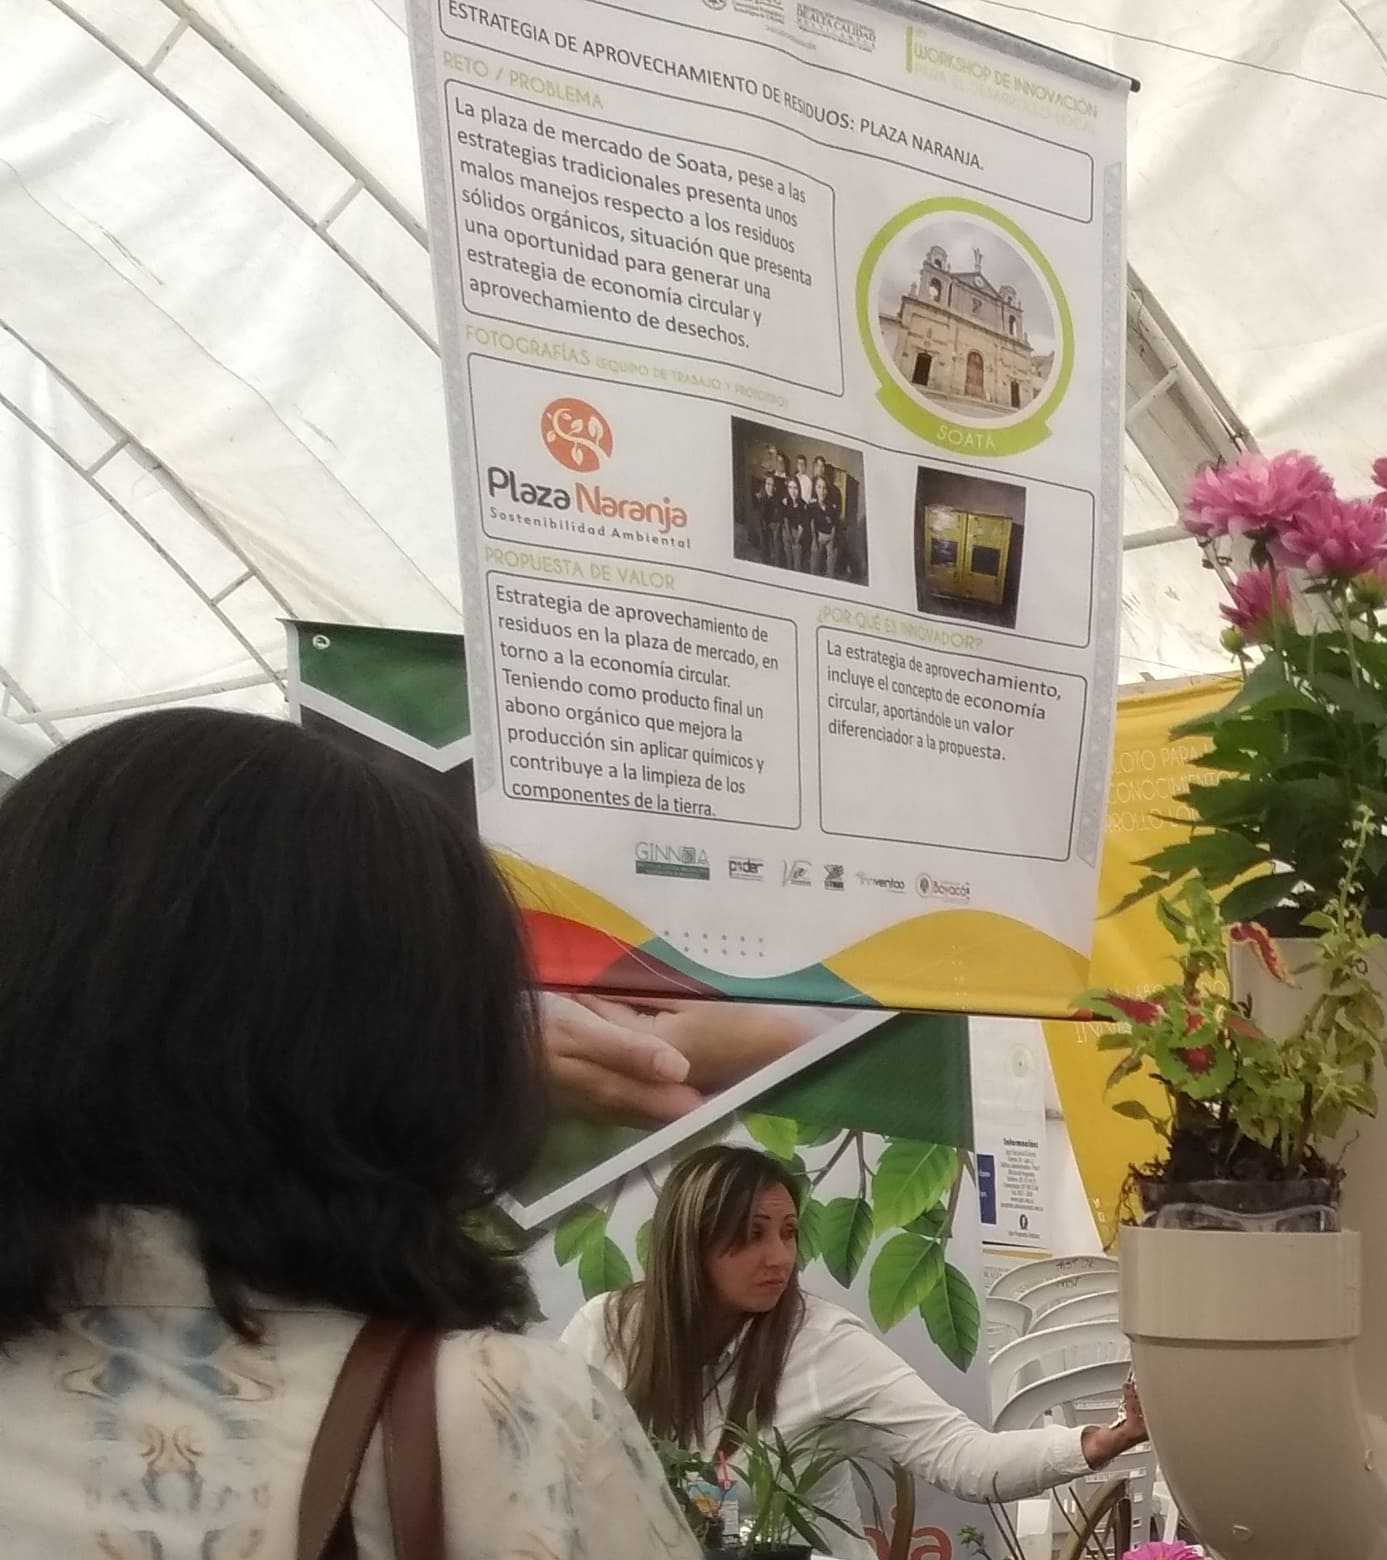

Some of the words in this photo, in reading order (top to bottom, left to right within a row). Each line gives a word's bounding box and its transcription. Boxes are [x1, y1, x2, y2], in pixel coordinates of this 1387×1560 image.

[444, 51, 488, 77] RETO
[510, 70, 602, 109] PROBLEMA
[450, 0, 550, 43] ESTRATEGIA
[554, 32, 577, 52] DE
[583, 40, 758, 94] APROVECHAMIENTO
[762, 83, 780, 103] DE
[784, 91, 854, 130] RESIDUOS:
[860, 118, 907, 145] PLAZA
[912, 134, 983, 170] NARANJA.
[455, 96, 474, 117] La
[481, 106, 527, 131] plaza
[533, 119, 555, 139] de
[562, 130, 642, 159] mercado
[648, 147, 670, 166] de
[676, 152, 732, 181] Soata,
[738, 169, 773, 191] pese
[777, 182, 784, 195] a
[788, 181, 805, 203] las
[457, 130, 556, 167] estrategias
[562, 155, 680, 195] tradicionales
[686, 186, 760, 214] presenta
[766, 205, 797, 227] unos
[460, 160, 514, 185] malos
[520, 176, 598, 205] manejos
[604, 196, 683, 223] respecto
[690, 214, 699, 226] a
[705, 212, 730, 233] los
[735, 223, 794, 253] residuos
[466, 326, 591, 365] FOTOGRAFÍAS
[936, 424, 995, 449] SOATÁ
[487, 466, 570, 510] Plaza
[575, 482, 687, 534] Naranja
[490, 506, 605, 536] Sostenibilidad
[611, 528, 690, 548] Ambiental
[486, 548, 584, 577] PROPUESTA
[591, 563, 612, 581] DE
[616, 568, 674, 590] VALOR
[496, 584, 582, 614] Estrategia
[588, 598, 609, 616] de
[615, 606, 747, 638] aprovechamiento
[752, 625, 768, 642] de
